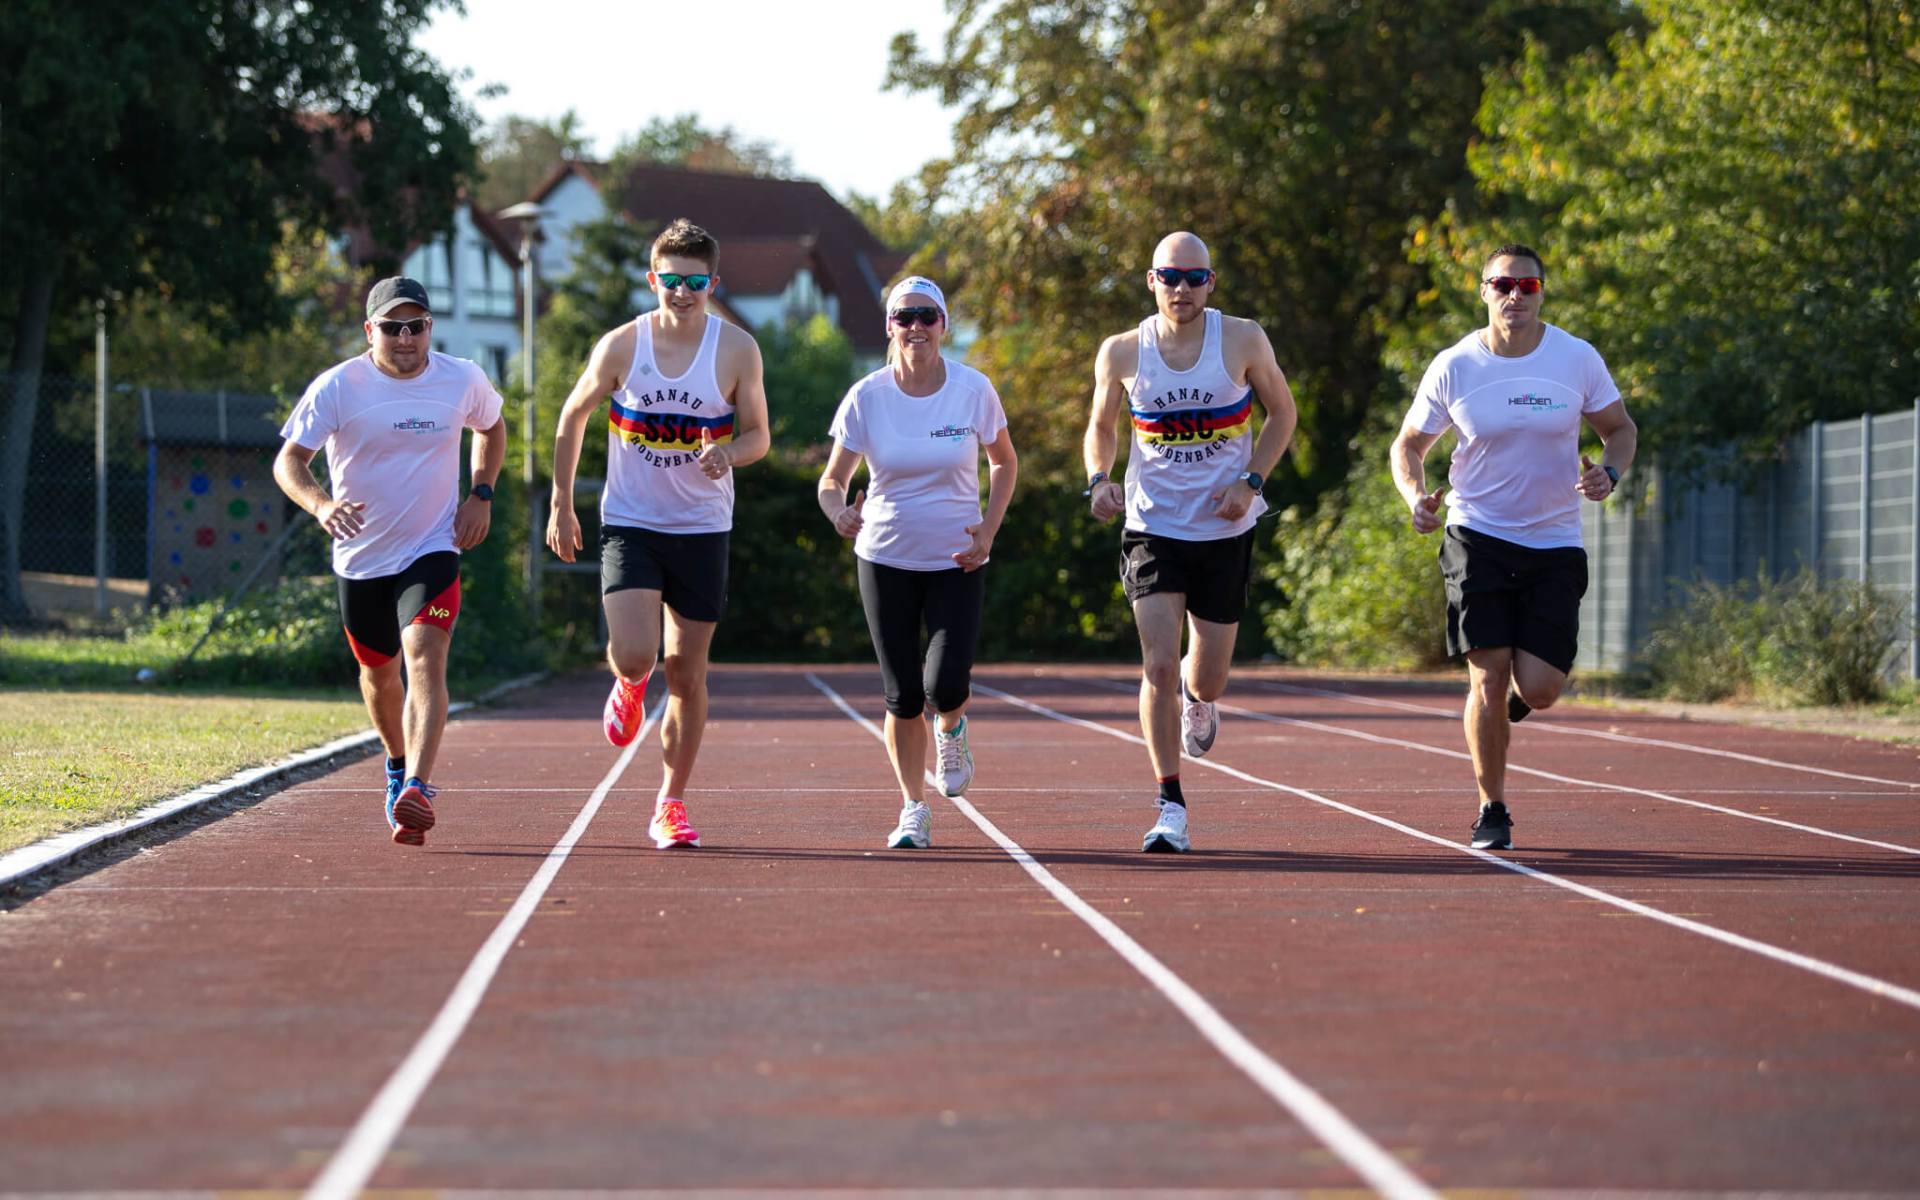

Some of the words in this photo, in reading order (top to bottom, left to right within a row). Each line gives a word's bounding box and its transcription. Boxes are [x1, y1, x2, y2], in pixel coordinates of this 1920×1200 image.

[641, 389, 703, 410] HANAU
[1154, 388, 1214, 409] HANAU
[1508, 397, 1552, 405] HELDEN
[394, 421, 434, 430] HELDEN
[645, 414, 697, 445] SSC
[931, 427, 970, 438] HELDEN
[1161, 411, 1214, 441] SSC
[630, 435, 703, 468] RODENBAC
[1150, 433, 1229, 463] RODENBACH
